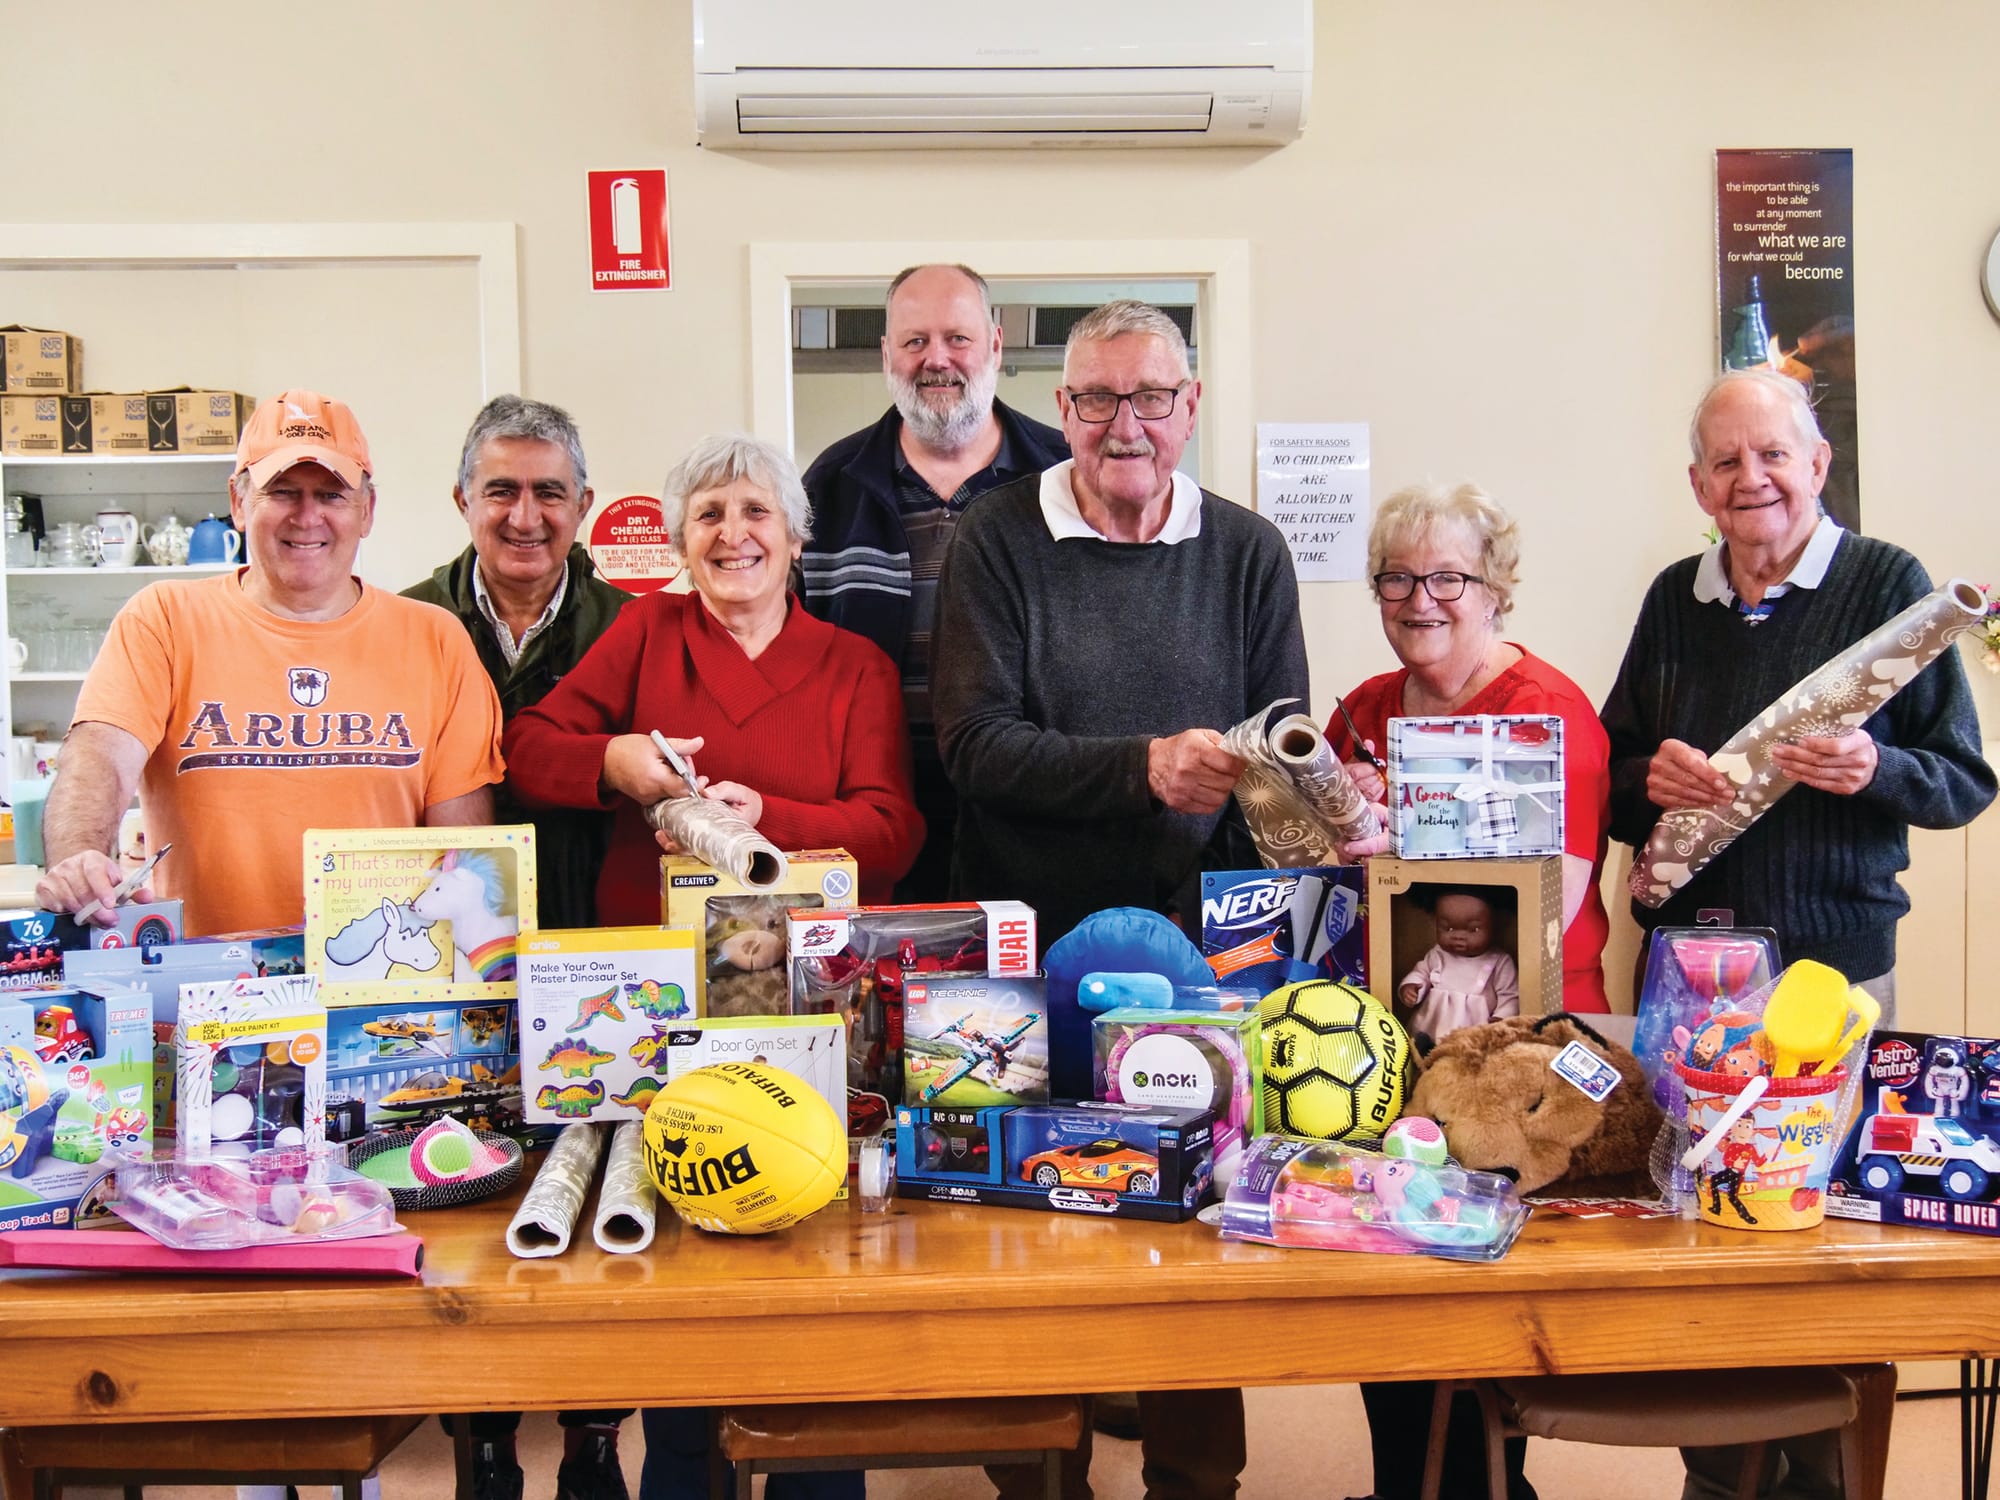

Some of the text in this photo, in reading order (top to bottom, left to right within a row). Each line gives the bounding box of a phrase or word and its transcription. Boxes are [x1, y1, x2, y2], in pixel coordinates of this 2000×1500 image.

[1726, 181, 1820, 194] the important thing is
[1766, 195, 1808, 205] to be able
[1756, 209, 1822, 221] at any moment
[1733, 221, 1787, 232] to surrender
[1758, 232, 1846, 248] what we are
[1727, 251, 1803, 262] for what we could
[620, 259, 641, 270] FIRE
[595, 269, 666, 281] EXTINGUISHER
[1785, 264, 1844, 280] become
[286, 431, 305, 439] GOLF
[1270, 438, 1351, 447] FOR SAFETY REASONS
[1272, 455, 1355, 465] NO CHILDREN
[1300, 474, 1328, 485] ARE
[1275, 493, 1353, 504] ALLOWED IN
[608, 504, 622, 516] THIS
[627, 516, 650, 525] DRY
[1273, 513, 1355, 523] THE KITCHEN
[610, 526, 667, 536] CHEMICAL
[1288, 530, 1340, 543] AT ANY
[640, 535, 662, 543] CLASS
[1296, 551, 1328, 562] TIME.
[220, 754, 388, 765] ESTABLISHED 1499
[1428, 801, 1439, 810] for
[1440, 807, 1450, 815] the
[1418, 815, 1459, 829] holidays
[338, 853, 425, 871] That's not
[325, 878, 352, 895] my
[674, 877, 708, 886] CREATIVE
[1378, 876, 1399, 886] Folk
[1202, 881, 1298, 928] NERF
[24, 920, 44, 936] 76
[530, 961, 615, 973] Make Your Own
[531, 971, 638, 984] Plaster Dinosaur Set
[930, 988, 988, 998] TECHNIC
[110, 1007, 147, 1022] TRY ME!
[711, 1037, 798, 1054] Door Gym Set
[1270, 1029, 1280, 1068] BUFFALO
[1286, 1033, 1297, 1067] SPORTS
[1872, 1048, 1917, 1065] Astro
[1371, 1019, 1397, 1122] BUFFALO
[722, 1064, 797, 1109] BUFFALO
[671, 1109, 697, 1121] MATCH
[1806, 1105, 1821, 1118] The
[669, 1118, 691, 1133] GRASS
[693, 1124, 704, 1134] ON
[705, 1124, 723, 1134] USE
[735, 1194, 777, 1214] GUARANTEED
[1903, 1198, 1997, 1228] SPACE ROVER
[22, 1212, 51, 1227] Track
